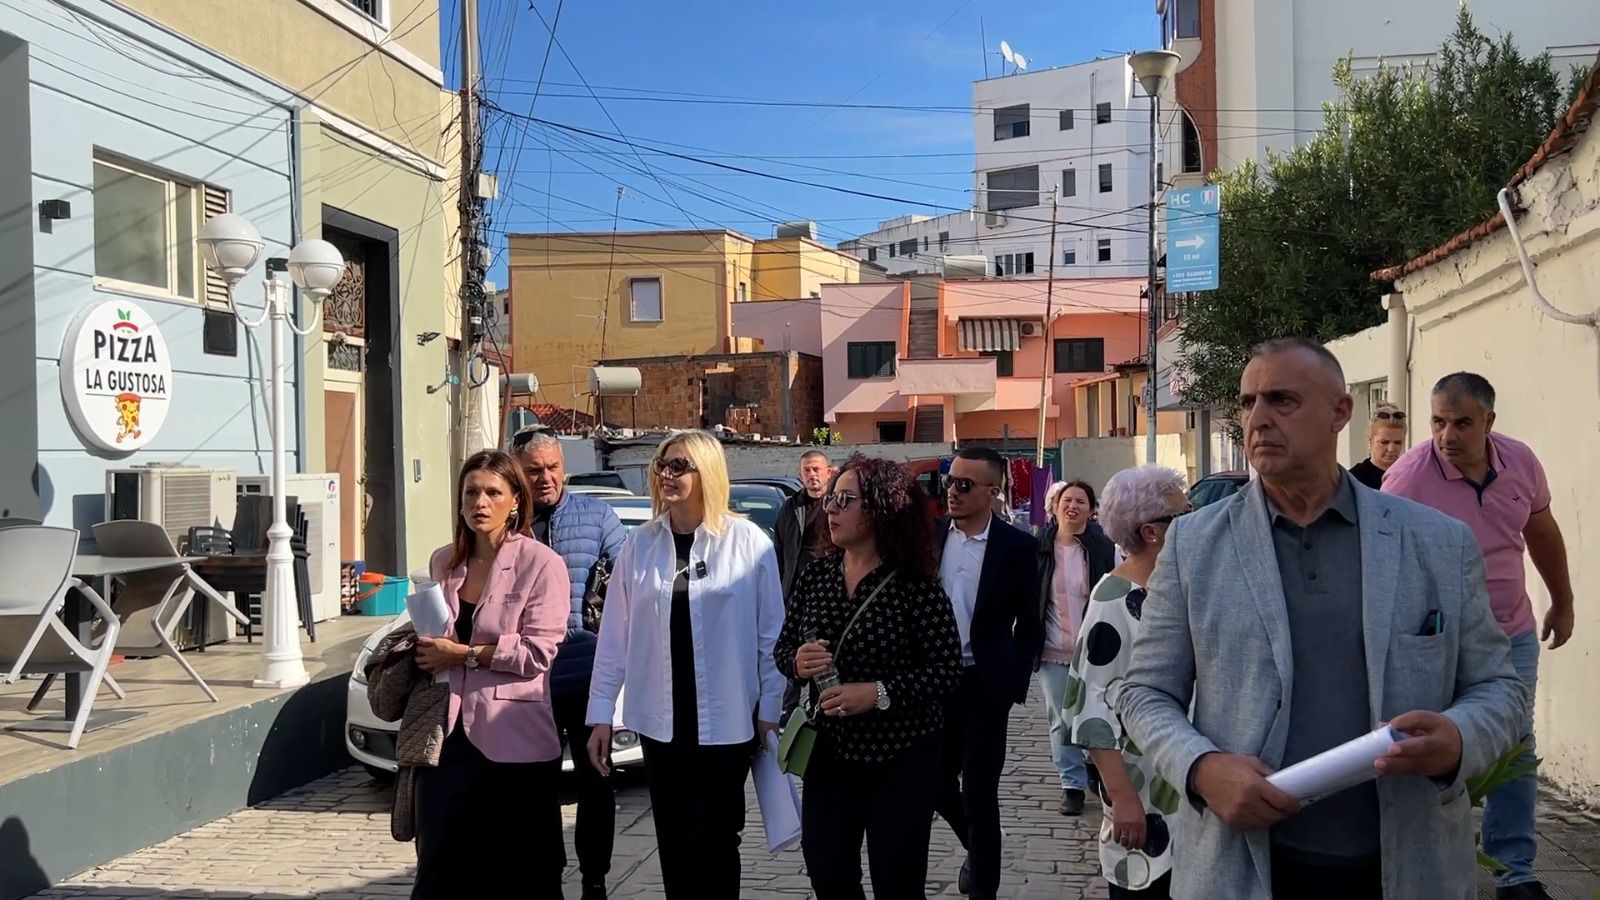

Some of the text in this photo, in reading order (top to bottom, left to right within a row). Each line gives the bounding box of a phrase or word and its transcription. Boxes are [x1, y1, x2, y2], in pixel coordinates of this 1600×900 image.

[1170, 193, 1191, 205] HC
[95, 329, 157, 363] PIZZA
[86, 368, 166, 394] LA GUSTOSA
